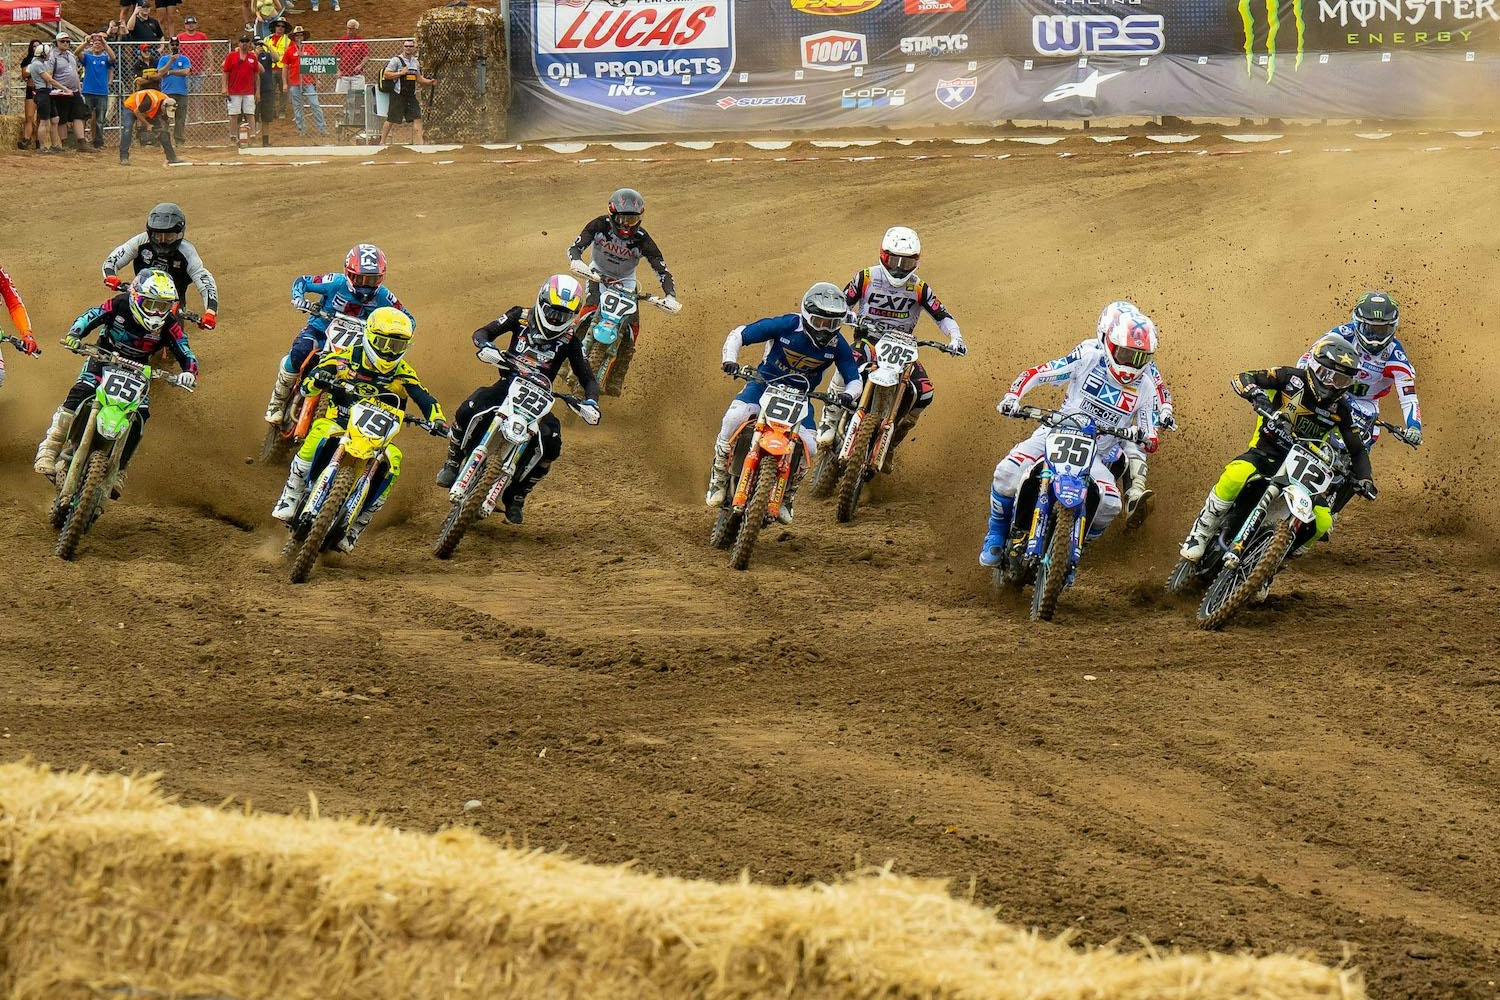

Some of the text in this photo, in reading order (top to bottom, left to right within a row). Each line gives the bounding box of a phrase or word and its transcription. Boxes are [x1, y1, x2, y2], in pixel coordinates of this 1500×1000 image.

[917, 3, 954, 11] HONDA
[555, 5, 718, 49] LUCAS
[1035, 17, 1164, 54] WPS
[1347, 31, 1474, 45] ENERGY
[809, 39, 858, 64] 100%
[899, 33, 969, 53] STACYC
[300, 57, 336, 66] MECHANICS
[309, 65, 327, 73] AREA
[547, 57, 722, 80] OIL PRODUCTS
[607, 84, 656, 97] INC.
[737, 94, 807, 107] SUZUKI
[842, 88, 907, 98] GoPro
[603, 294, 634, 317] 97
[879, 343, 915, 366] 285
[104, 373, 143, 403] 65
[1082, 373, 1139, 413] FXR
[512, 386, 549, 416] 323
[764, 394, 803, 424] 61
[355, 408, 392, 436] 19
[1050, 435, 1092, 467] 35
[1291, 454, 1326, 494] 12
